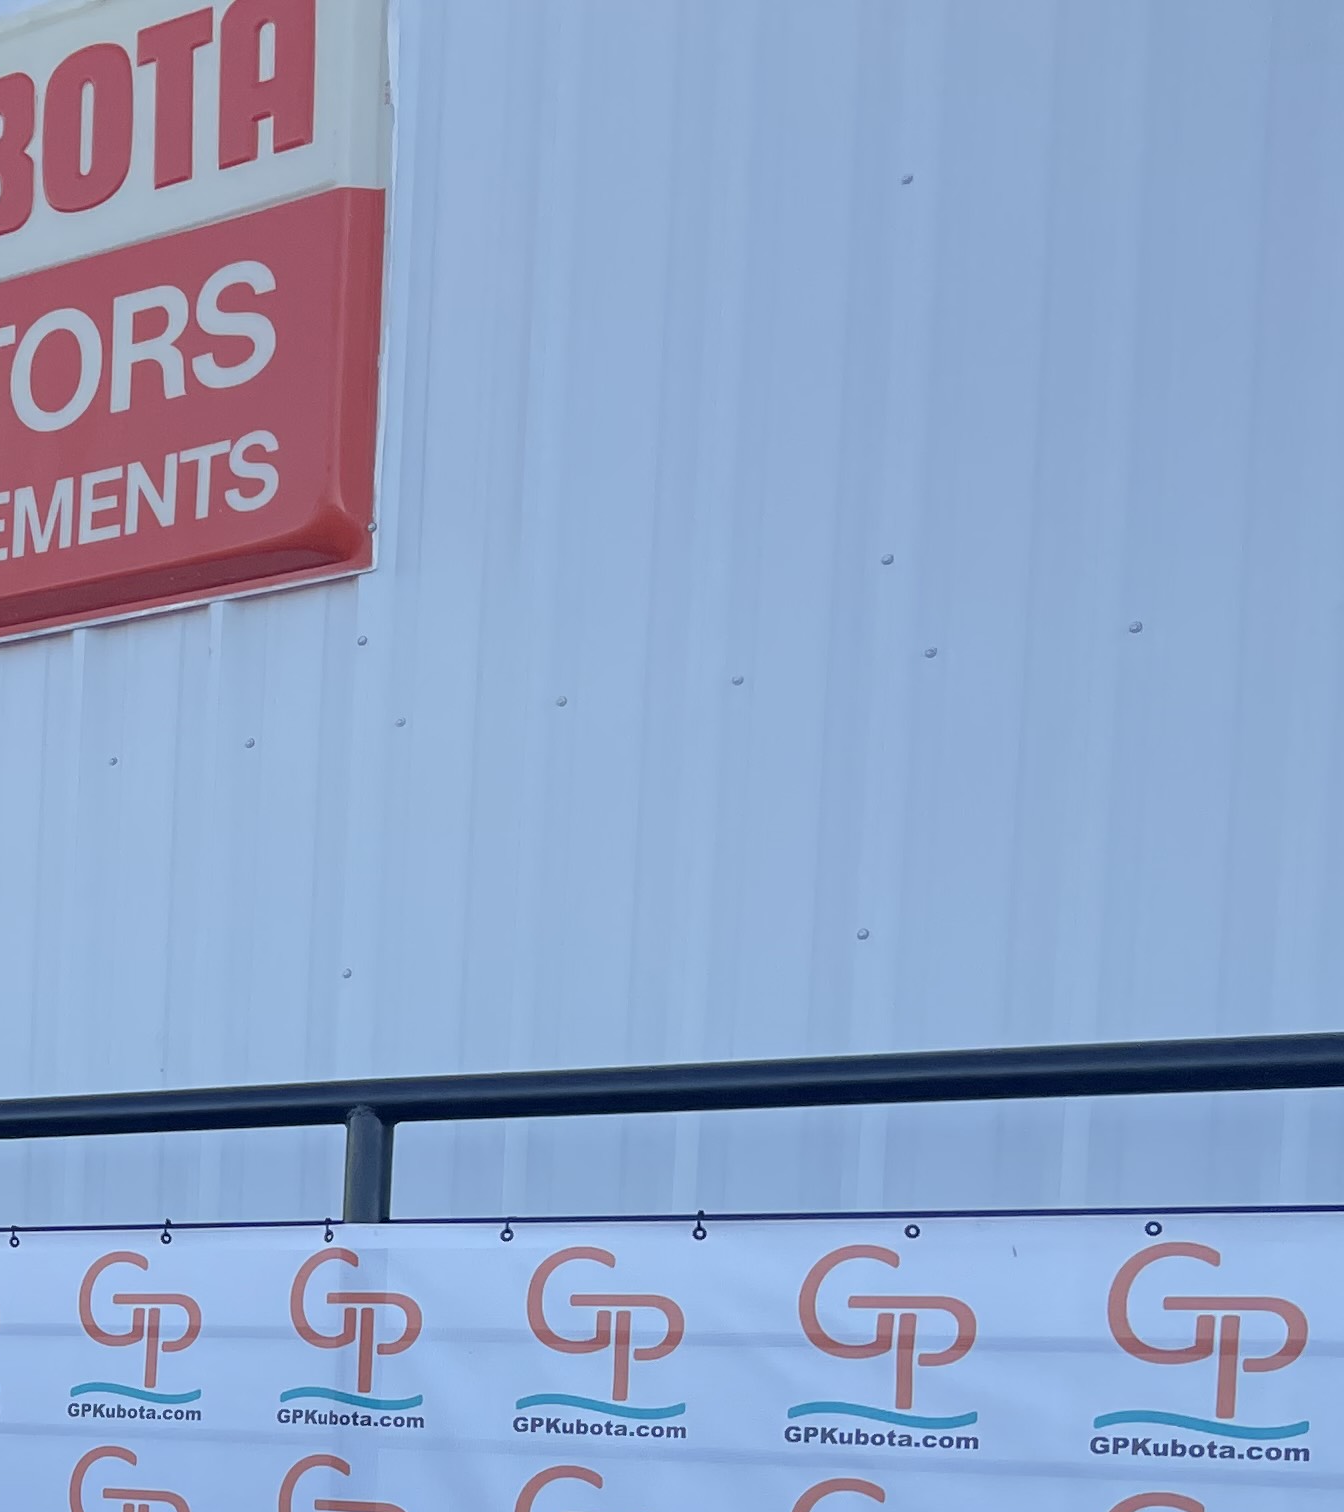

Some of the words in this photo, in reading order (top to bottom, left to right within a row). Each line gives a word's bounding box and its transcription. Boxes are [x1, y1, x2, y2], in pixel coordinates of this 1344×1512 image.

[79, 1251, 201, 1388] GP
[290, 1247, 422, 1393] GP
[527, 1246, 685, 1401] GP
[798, 1245, 977, 1409] GP
[1108, 1242, 1309, 1419] GP
[67, 1402, 202, 1421] GPKubota.com
[276, 1408, 425, 1429] GPKubota.com
[512, 1416, 687, 1439] GPKubota.com
[784, 1425, 979, 1450] GPKubota.com
[1089, 1436, 1310, 1462] GPKubota.com
